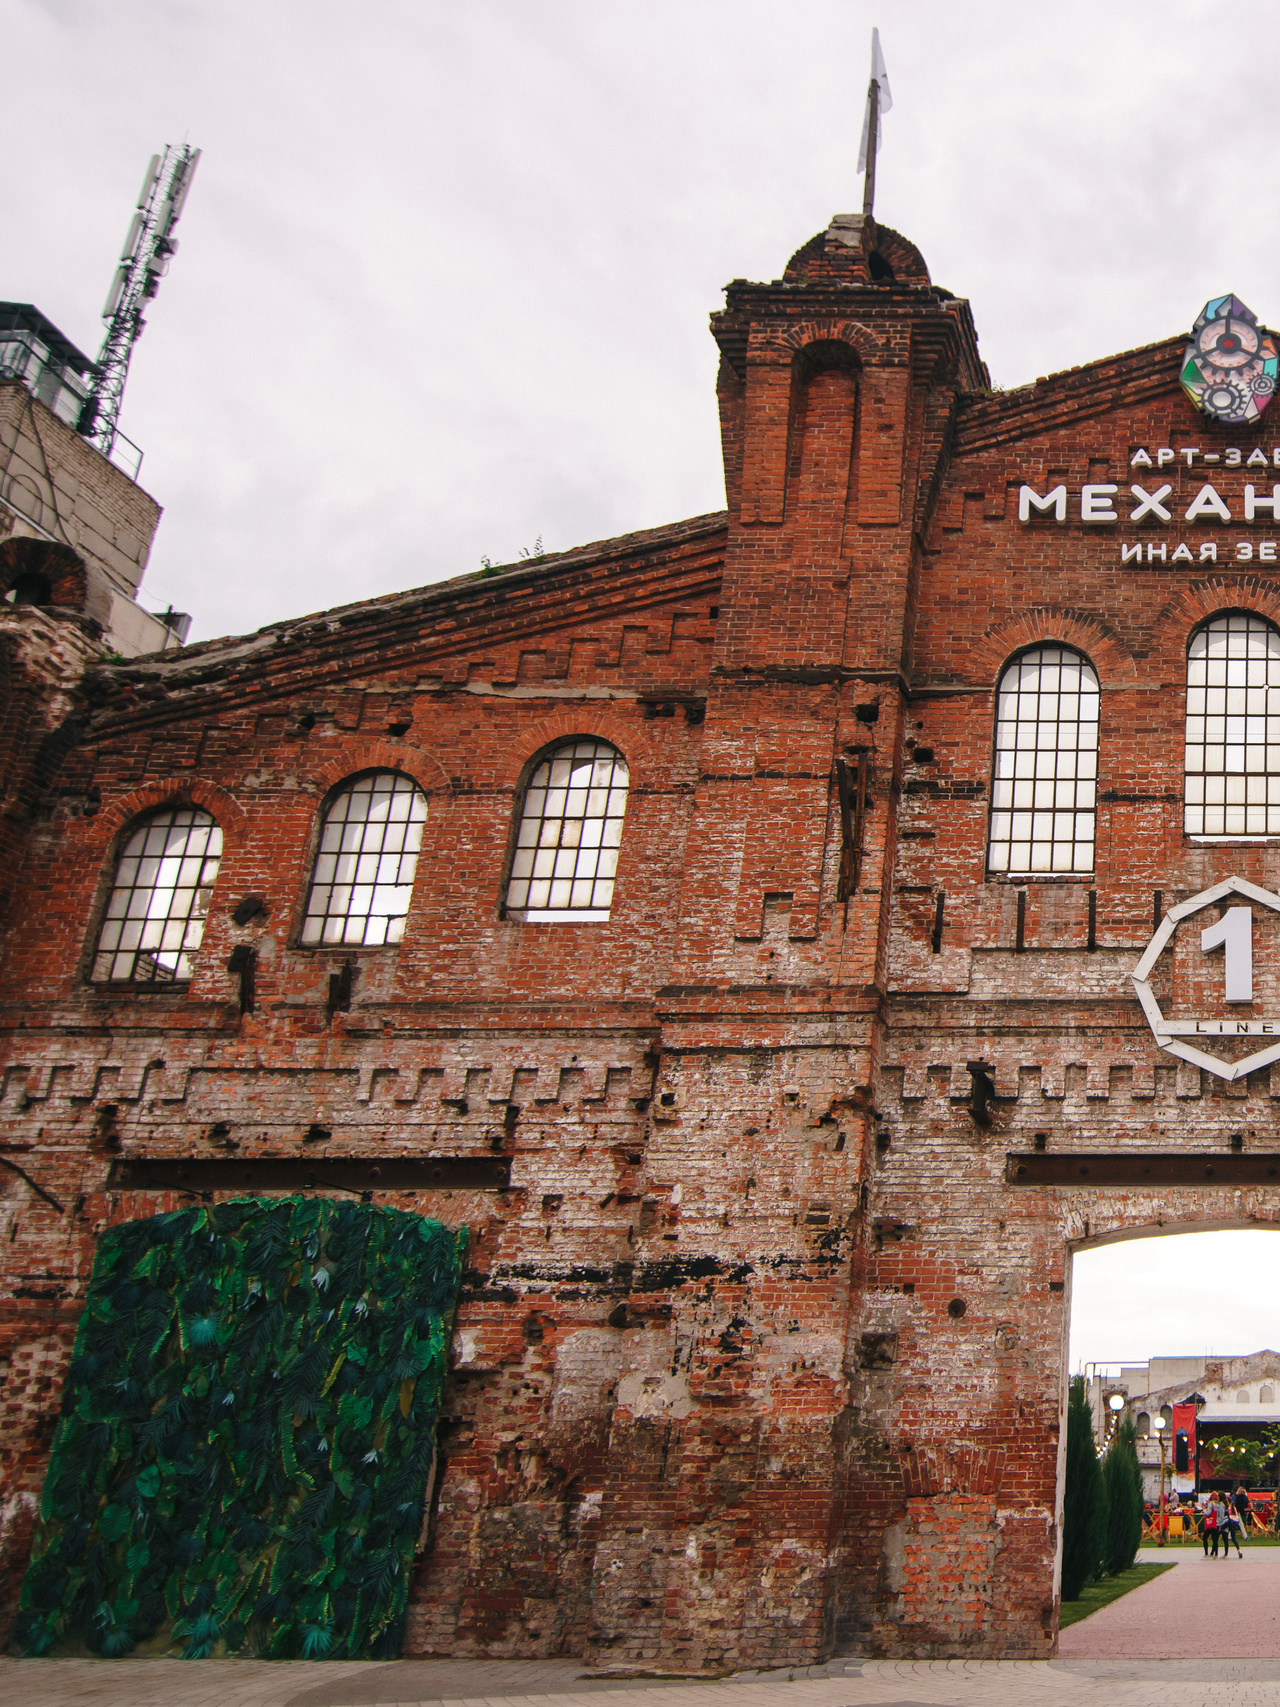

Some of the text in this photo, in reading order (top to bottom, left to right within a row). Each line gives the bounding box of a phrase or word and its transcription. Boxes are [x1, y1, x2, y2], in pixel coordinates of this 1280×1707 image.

[1121, 541, 1218, 564] ИНАЯ
[1201, 906, 1252, 1001] 1
[1195, 1022, 1274, 1033] LINE
